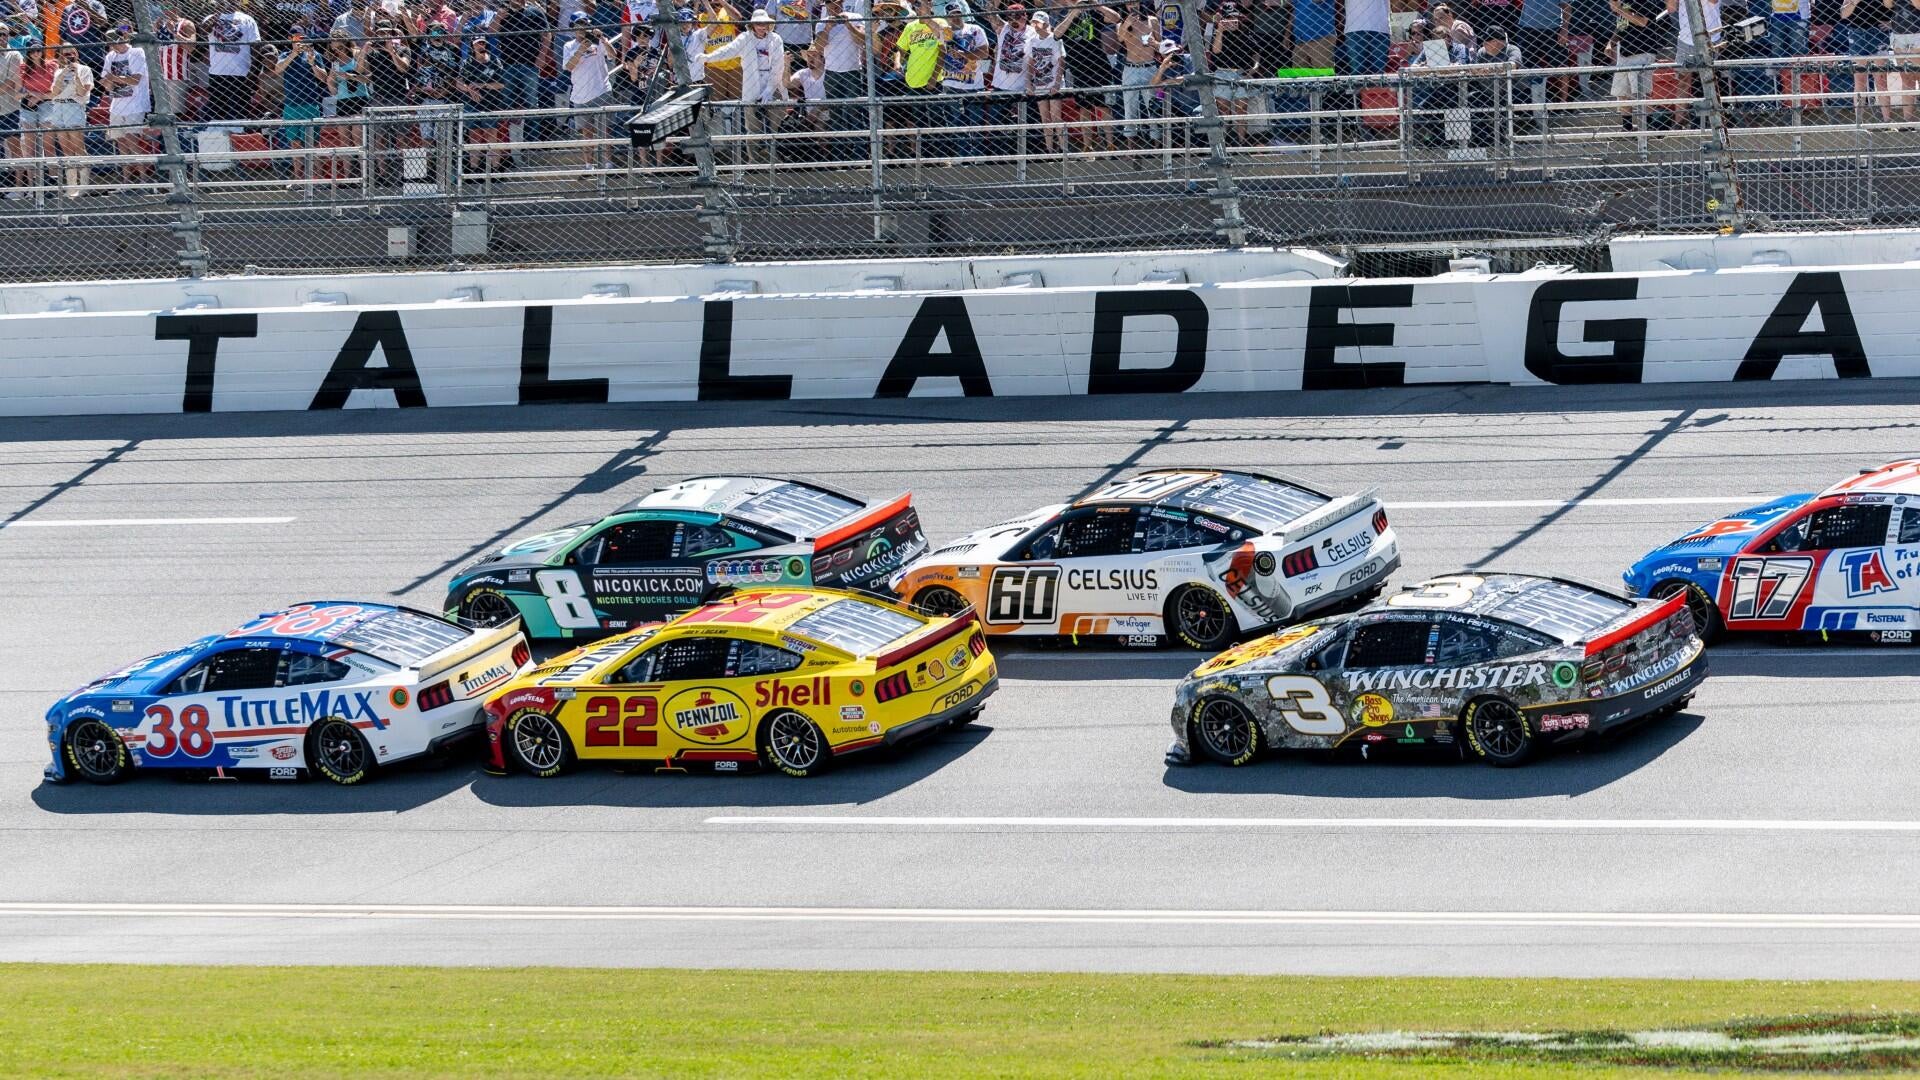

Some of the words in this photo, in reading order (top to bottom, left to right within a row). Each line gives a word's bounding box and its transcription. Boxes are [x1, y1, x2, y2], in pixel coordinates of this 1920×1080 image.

[155, 272, 1872, 413] TALLADEGA
[1200, 518, 1230, 533] Castrol
[1327, 531, 1372, 562] CELSIUS
[840, 540, 917, 583] NICOKICK.COM
[1349, 562, 1377, 585] FORD
[1653, 563, 1693, 577] GOODYEAR
[1843, 550, 1894, 595] TA
[1897, 563, 1912, 579] of
[593, 578, 704, 593] NICOKICK.COM
[1068, 569, 1158, 591] CELSIUS
[1728, 556, 1815, 621] 17
[535, 569, 601, 628] 8
[596, 596, 634, 605] NICOTINE
[635, 596, 672, 604] POUCHES
[986, 566, 1062, 624] 60
[1127, 593, 1146, 601] LIVE
[1219, 567, 1279, 623] CELSIUS
[1128, 635, 1157, 643] FORD
[1881, 630, 1912, 639] FORD
[1342, 663, 1549, 692] WINCHESTER
[1610, 645, 1696, 692] WINCHESTER
[755, 676, 831, 708] Shell
[1643, 667, 1692, 699] CHEVROLET
[944, 684, 974, 708] FORD
[1267, 675, 1347, 736] 3
[1364, 695, 1383, 705] Bass
[1406, 693, 1438, 704] American
[216, 690, 388, 731] TITLEMAX
[585, 696, 659, 747] 22
[675, 703, 740, 729] PENNZOIL
[1366, 704, 1380, 714] Pro
[1367, 712, 1390, 725] Shops
[145, 704, 213, 757] 38
[832, 726, 868, 734] Autotrader
[270, 768, 297, 776] FORD
